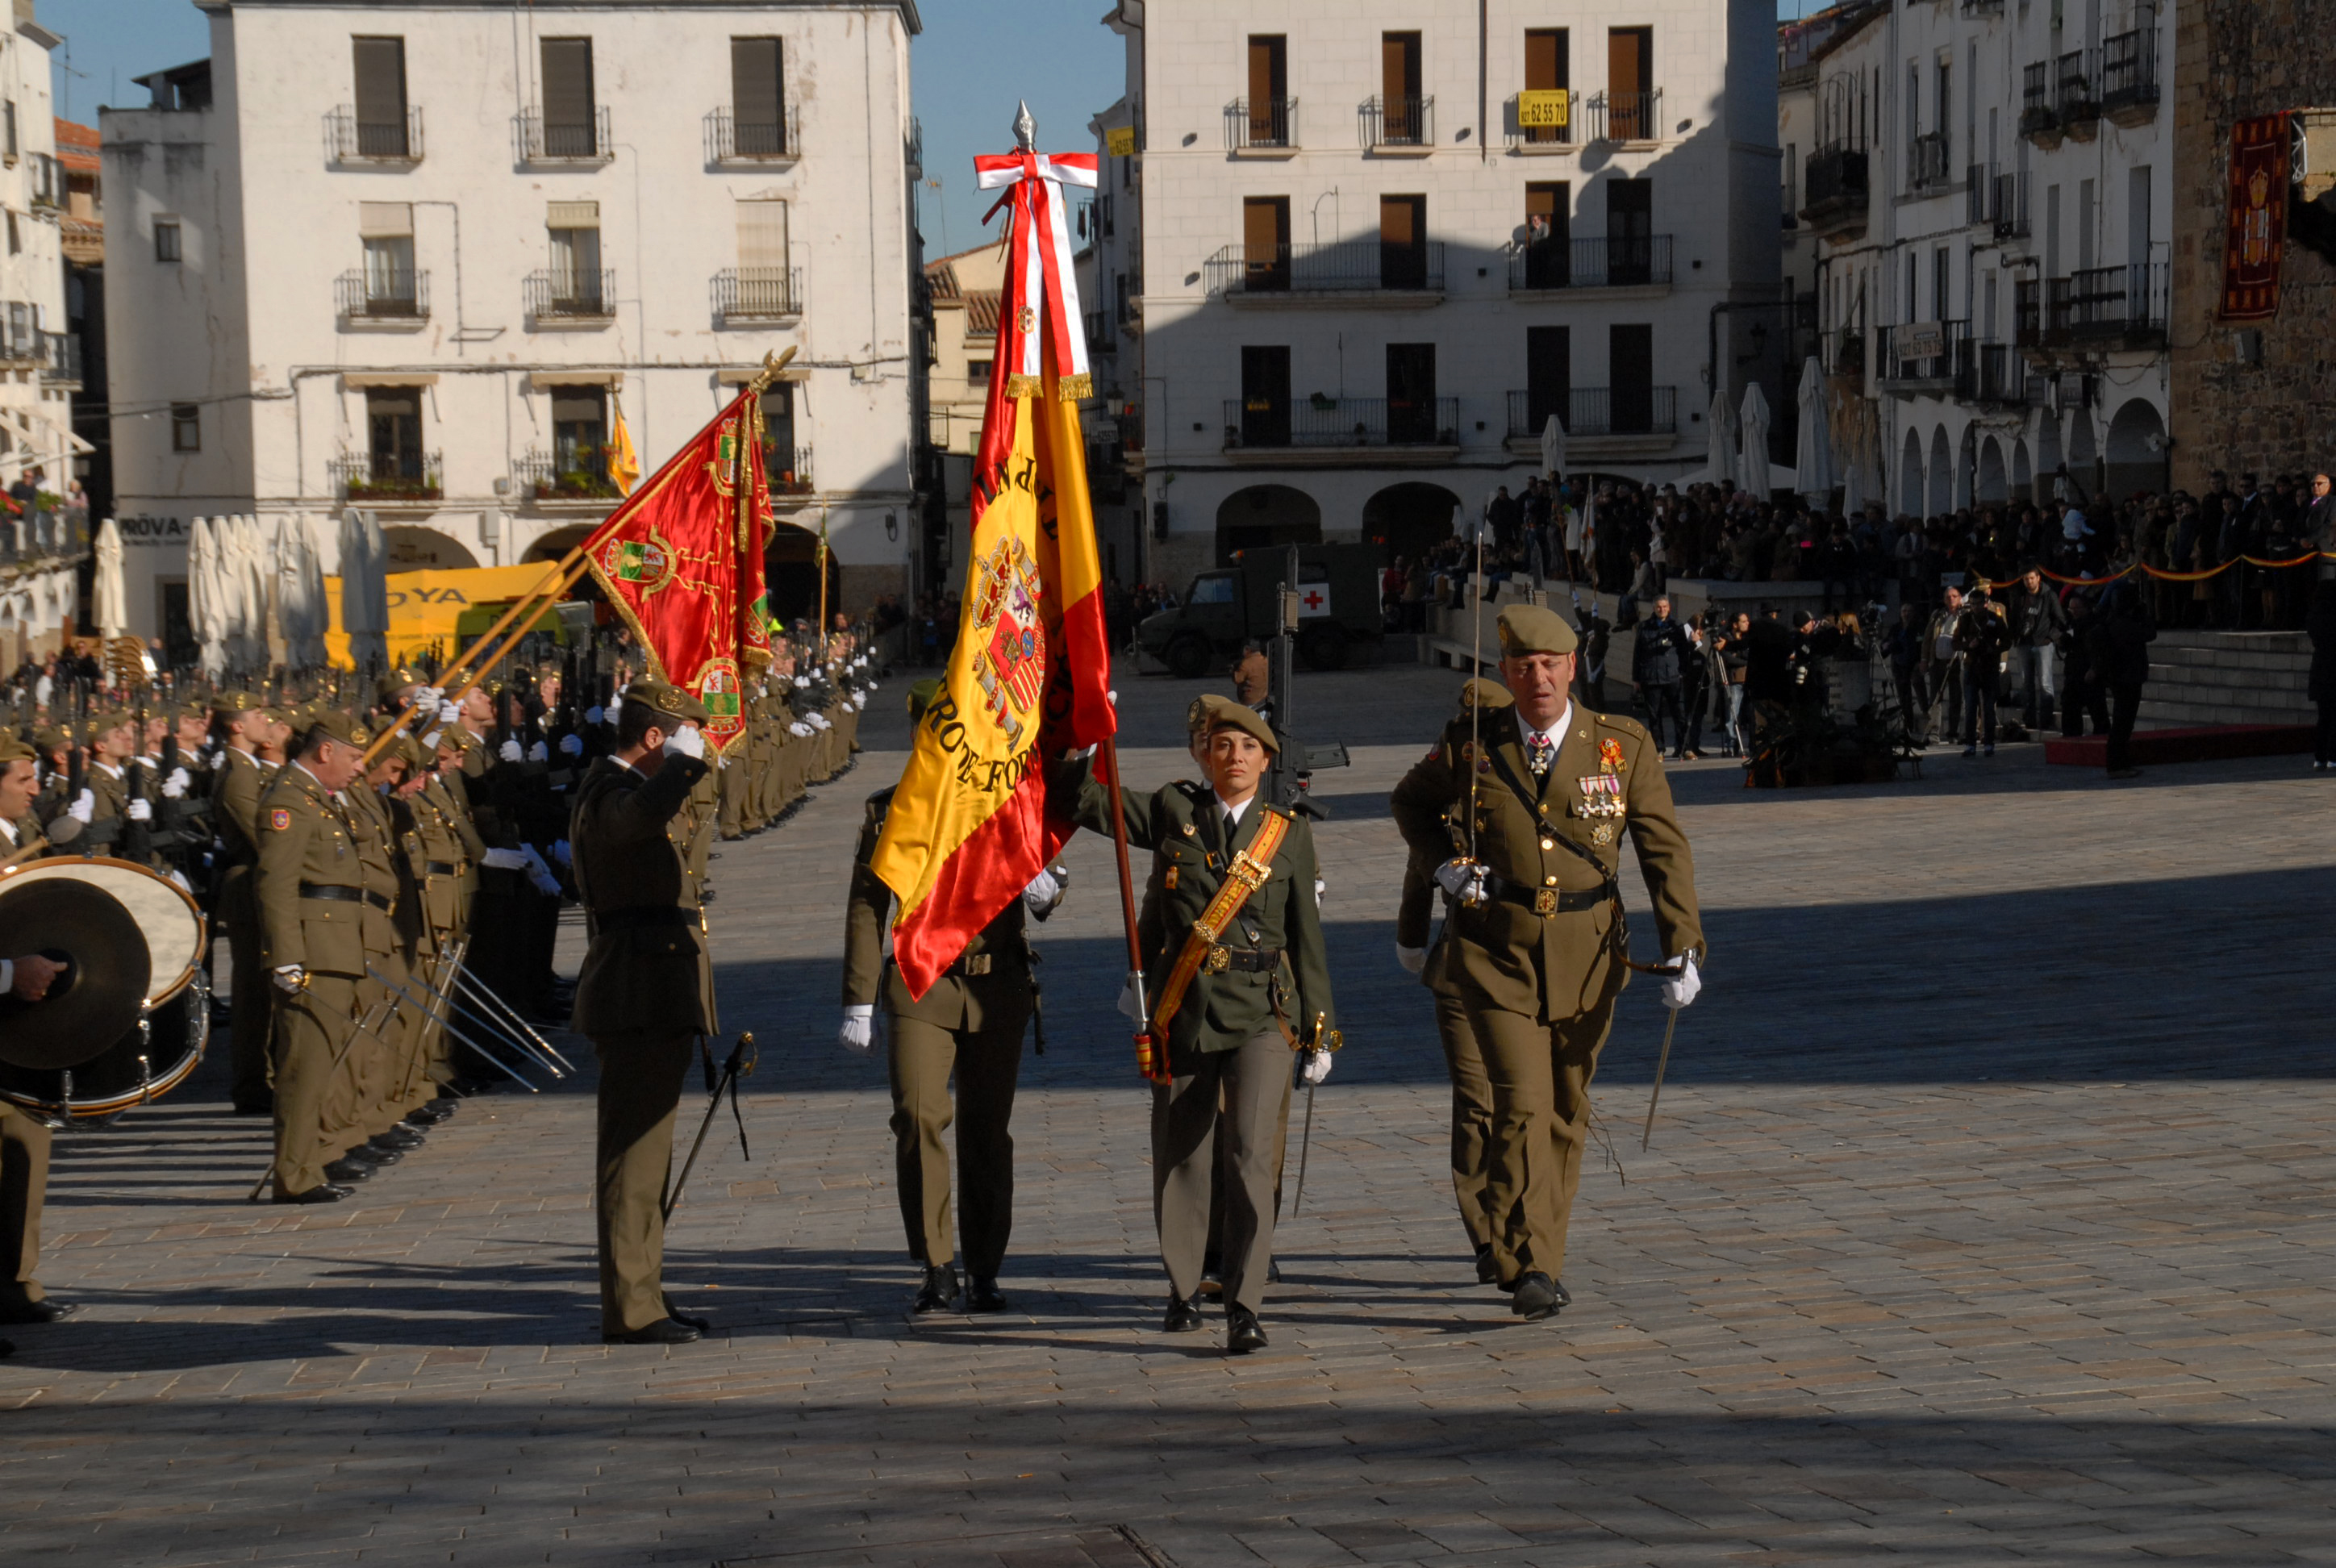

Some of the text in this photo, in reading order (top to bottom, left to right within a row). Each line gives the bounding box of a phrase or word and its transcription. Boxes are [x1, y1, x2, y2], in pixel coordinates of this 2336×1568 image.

[1520, 102, 1565, 123] 927 62 55 70
